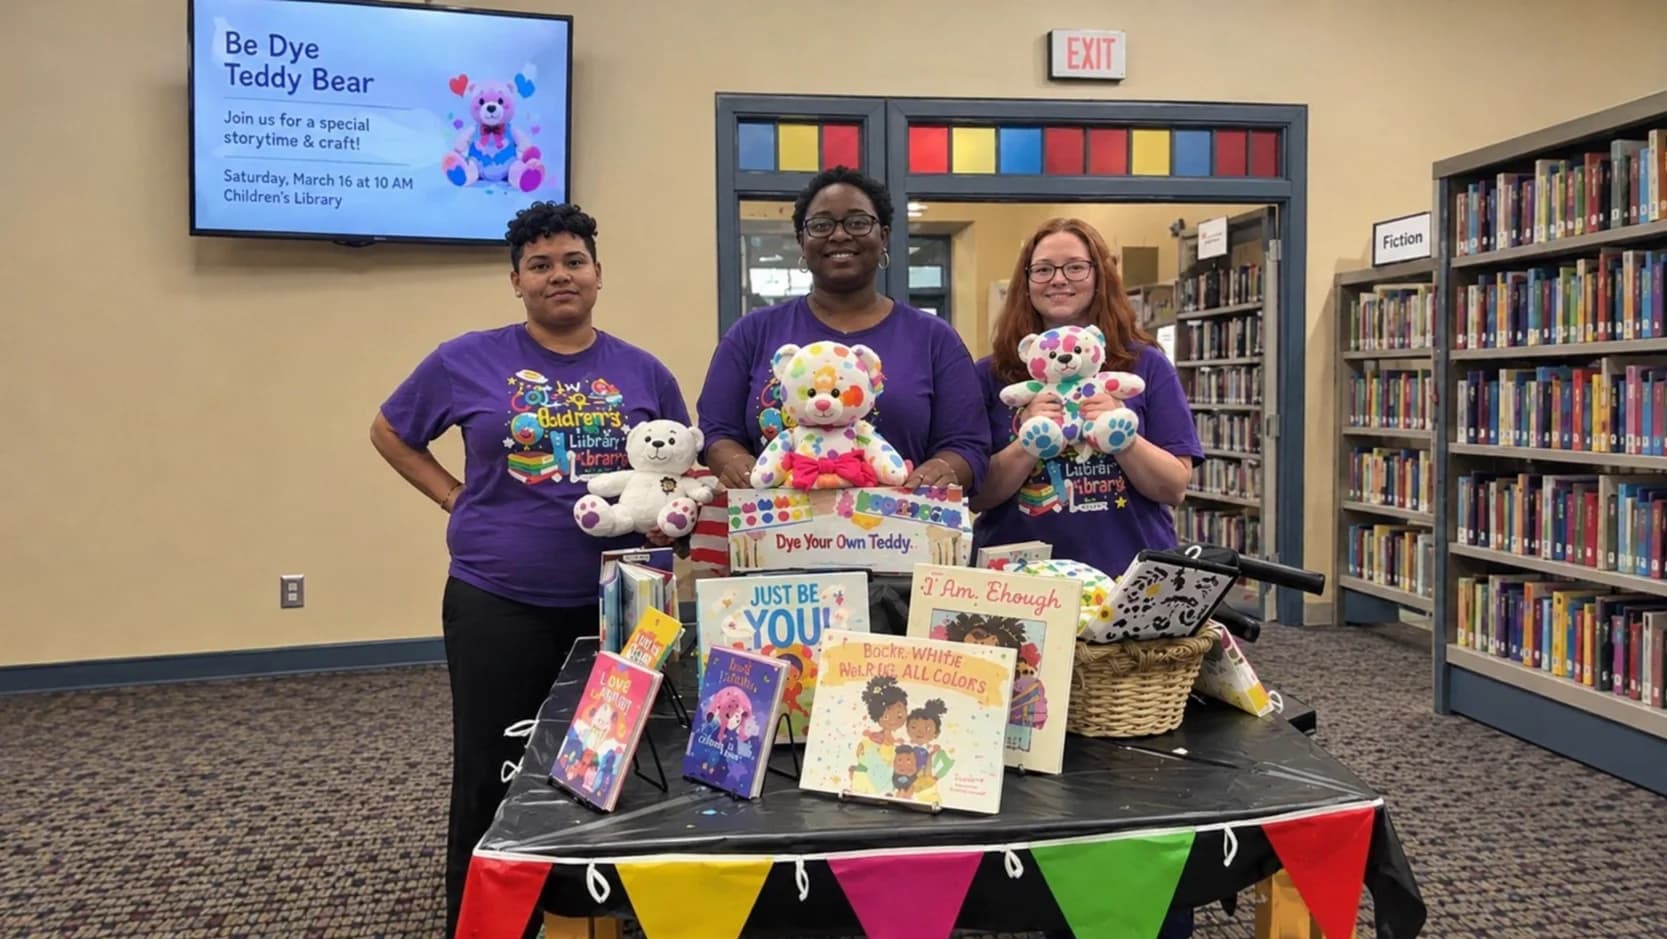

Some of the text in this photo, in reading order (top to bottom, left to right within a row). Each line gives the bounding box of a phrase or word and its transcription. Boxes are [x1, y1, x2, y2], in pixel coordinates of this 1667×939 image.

[226, 31, 319, 64] Be Dye
[1066, 36, 1115, 71] EXIT
[224, 62, 375, 95] Teddy Bear
[224, 110, 371, 133] Join us for a special
[224, 131, 361, 151] storytime & craft!
[224, 169, 414, 190] Saturday, March 16 at 10 AM
[224, 188, 343, 210] Children's Library
[1383, 232, 1424, 250] Fiction
[776, 533, 801, 553] Dye
[804, 534, 833, 550] Your
[836, 534, 866, 550] Own
[750, 583, 820, 606] JUST BE
[743, 606, 831, 650] YOU!
